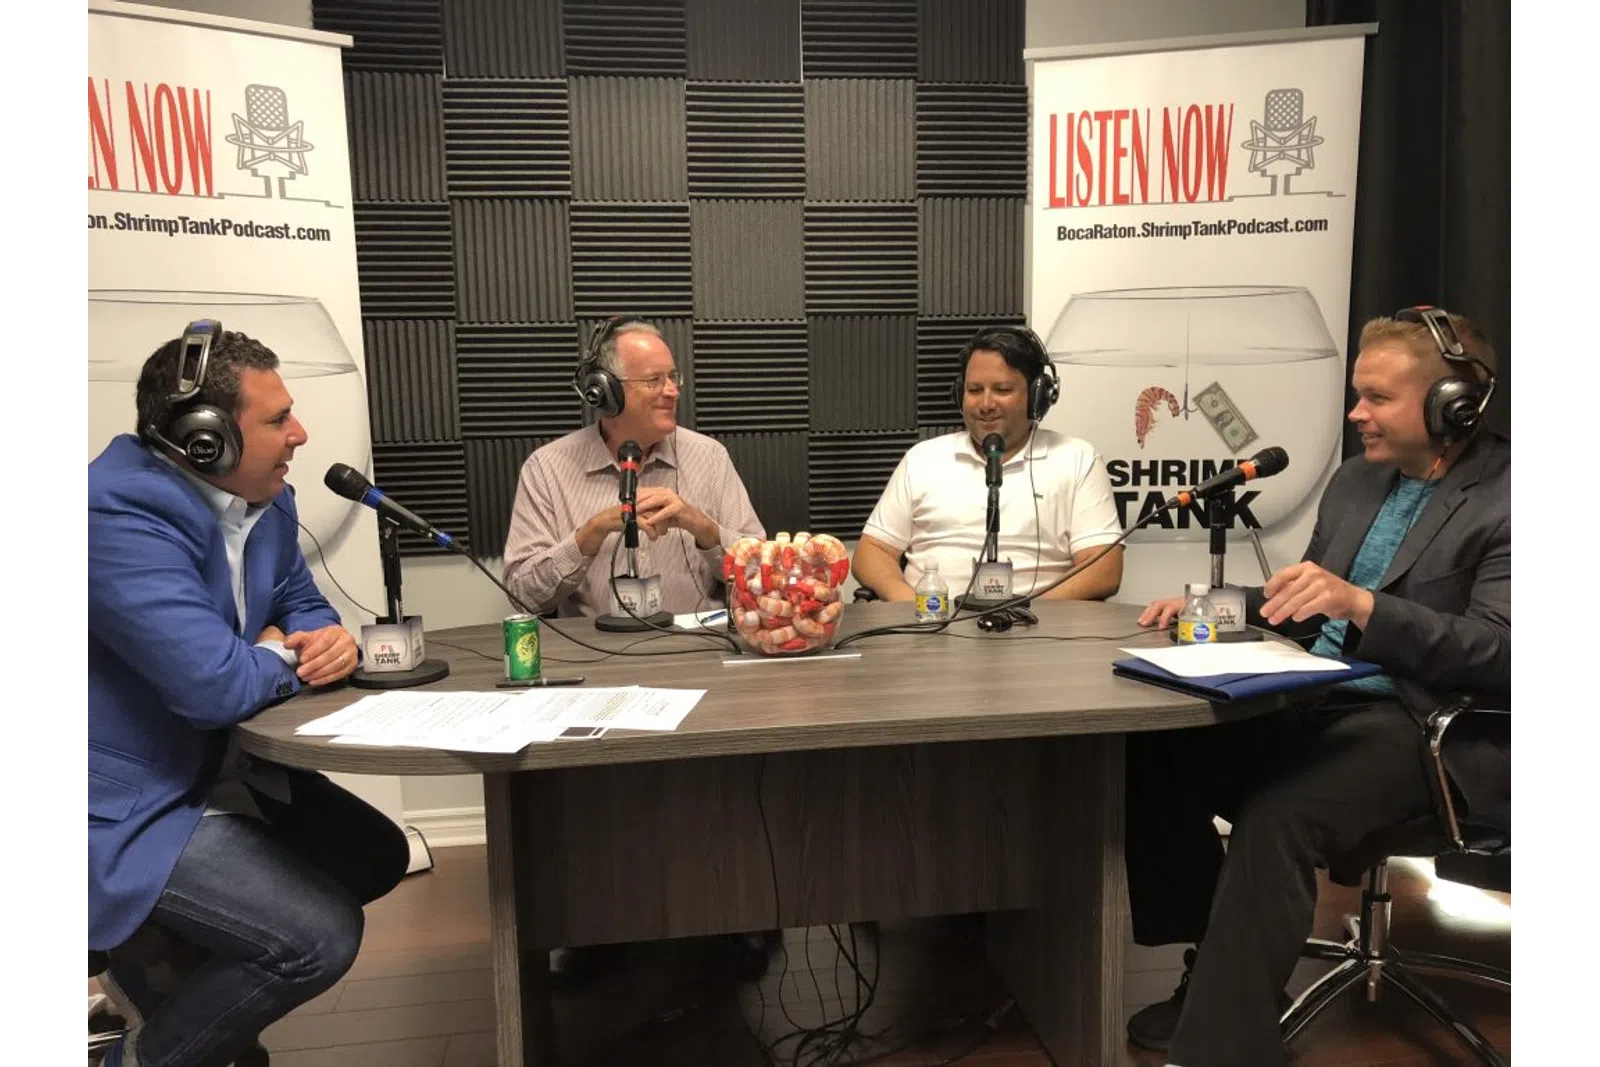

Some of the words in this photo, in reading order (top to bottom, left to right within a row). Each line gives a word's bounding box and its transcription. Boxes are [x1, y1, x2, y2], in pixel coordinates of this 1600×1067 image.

[88, 77, 118, 192] N
[126, 80, 213, 197] NOW
[1049, 107, 1151, 209] LISTEN
[1162, 103, 1234, 204] NOW
[1057, 217, 1329, 241] BocaRaton.ShrimpTankPodcast.com
